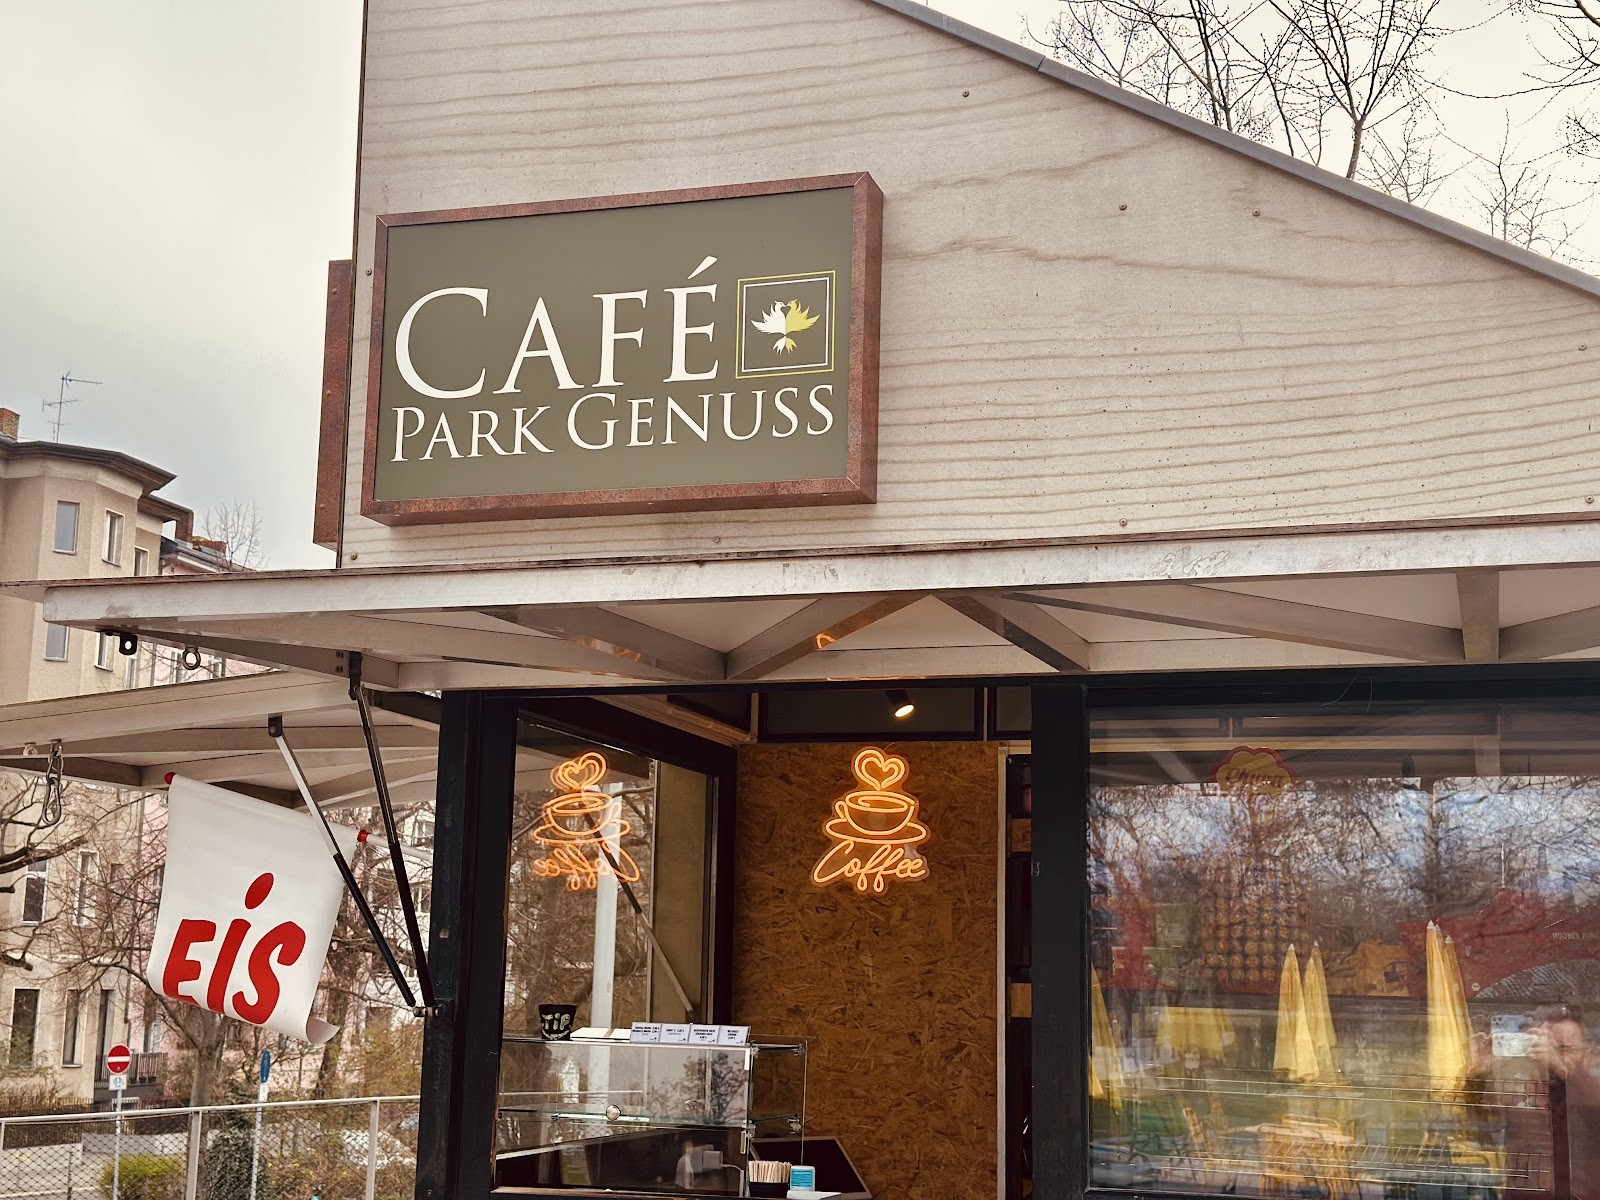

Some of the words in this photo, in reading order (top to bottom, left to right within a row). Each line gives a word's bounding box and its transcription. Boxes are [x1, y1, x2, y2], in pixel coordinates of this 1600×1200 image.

[395, 255, 719, 400] CAFÉ
[391, 405, 554, 462] PARK
[566, 384, 834, 450] GENUSS
[813, 839, 927, 893] Coffee
